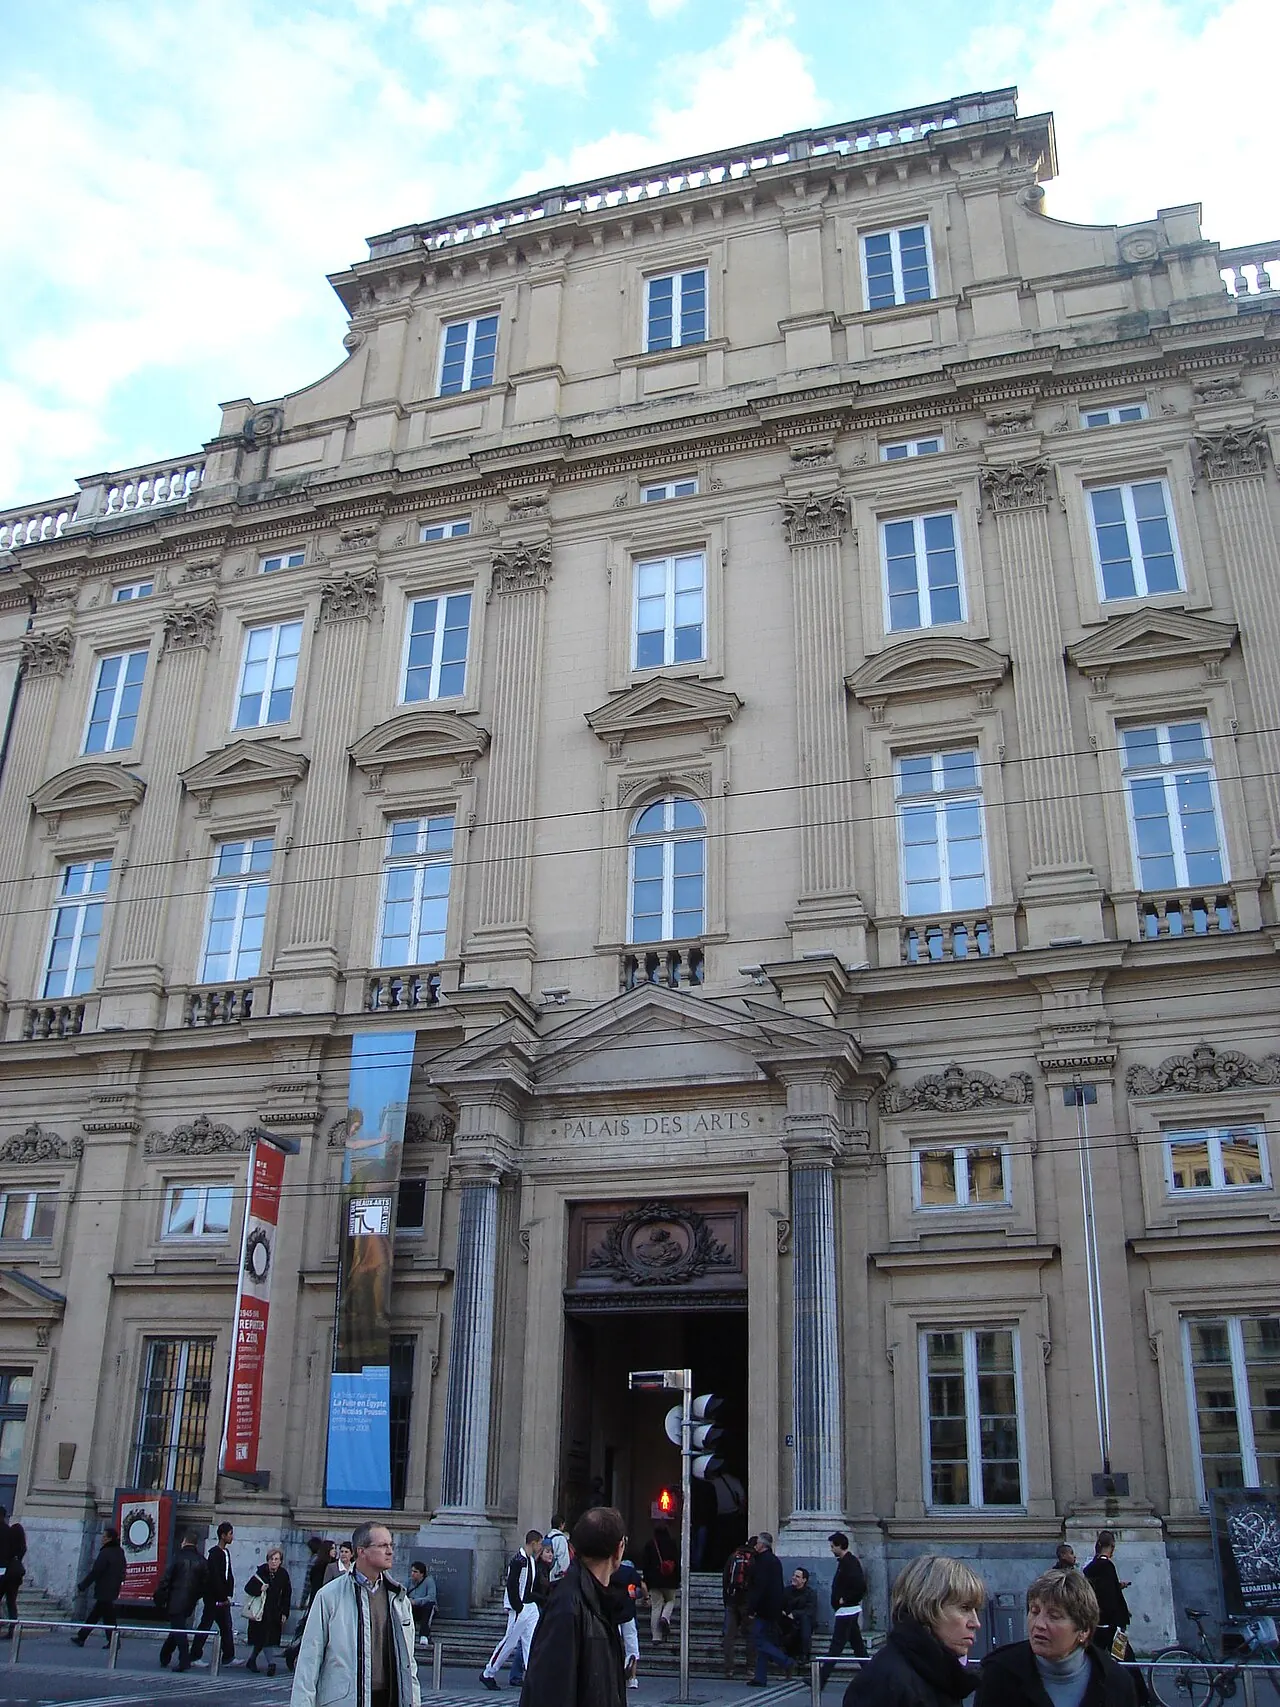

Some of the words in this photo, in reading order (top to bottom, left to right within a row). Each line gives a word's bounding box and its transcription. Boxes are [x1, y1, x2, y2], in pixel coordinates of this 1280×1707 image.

[563, 1119, 630, 1139] PALAIS
[643, 1115, 682, 1135] DES
[694, 1111, 751, 1132] ARTS
[1240, 1584, 1271, 1593] REPARTIR
